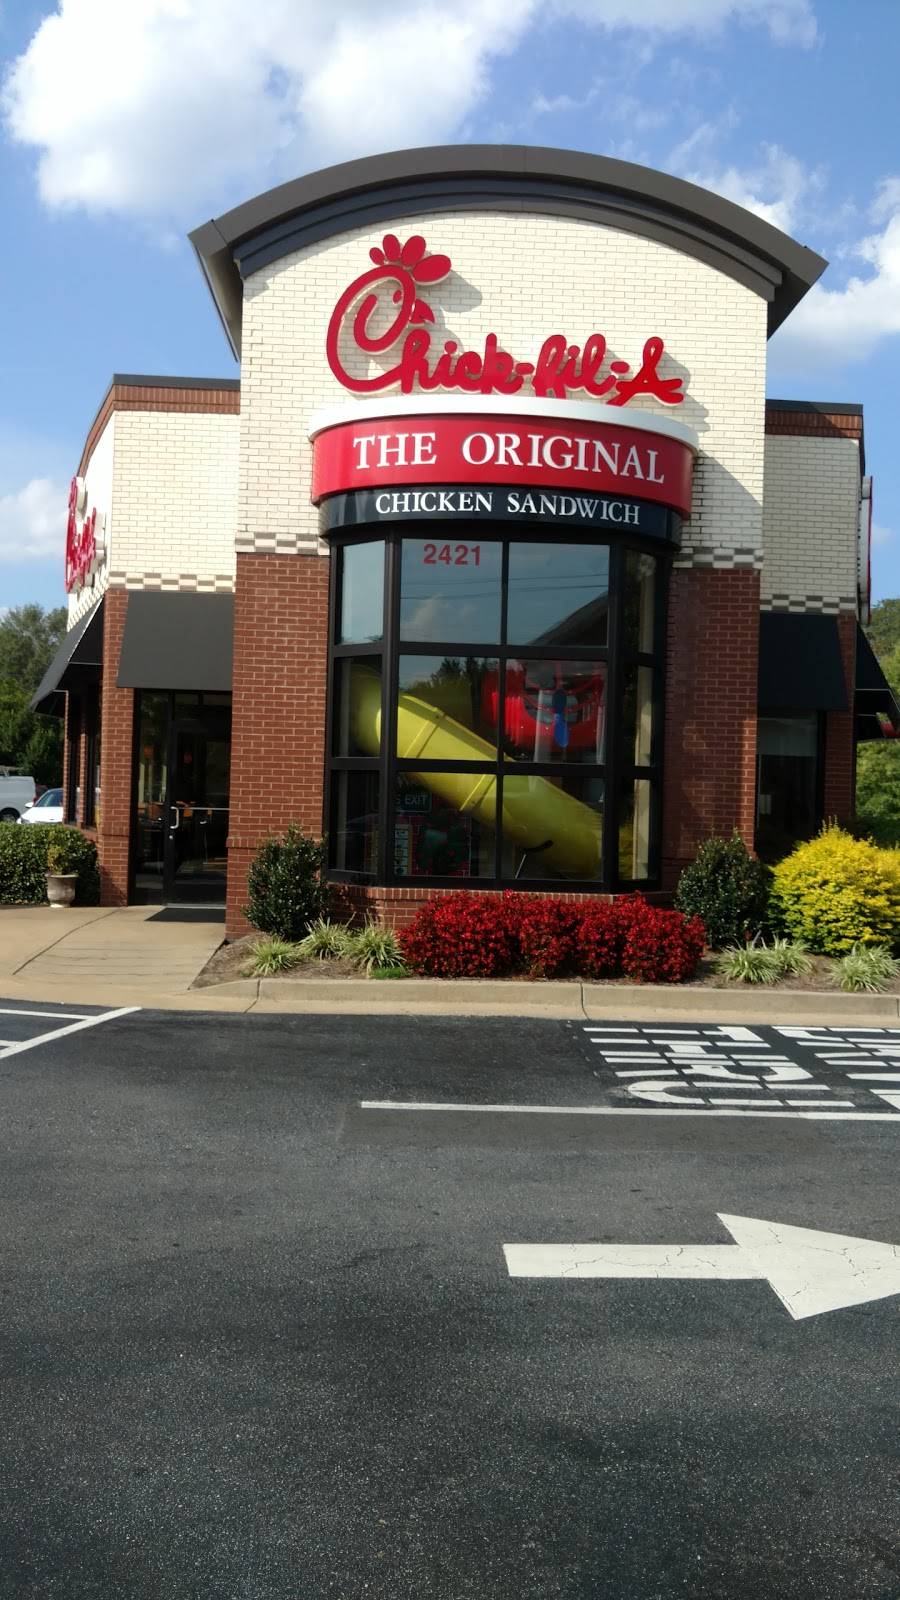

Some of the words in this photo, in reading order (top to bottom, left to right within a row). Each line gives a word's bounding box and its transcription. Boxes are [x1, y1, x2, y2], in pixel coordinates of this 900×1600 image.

[326, 264, 684, 407] Chick-fil-A
[353, 432, 437, 470] THE
[462, 431, 666, 484] ORIGINAL
[375, 491, 493, 514] CHICKEN
[507, 491, 640, 525] SANDWICH
[423, 544, 481, 566] 2421
[404, 793, 428, 806] EXIT
[582, 1025, 857, 1109] THRU
